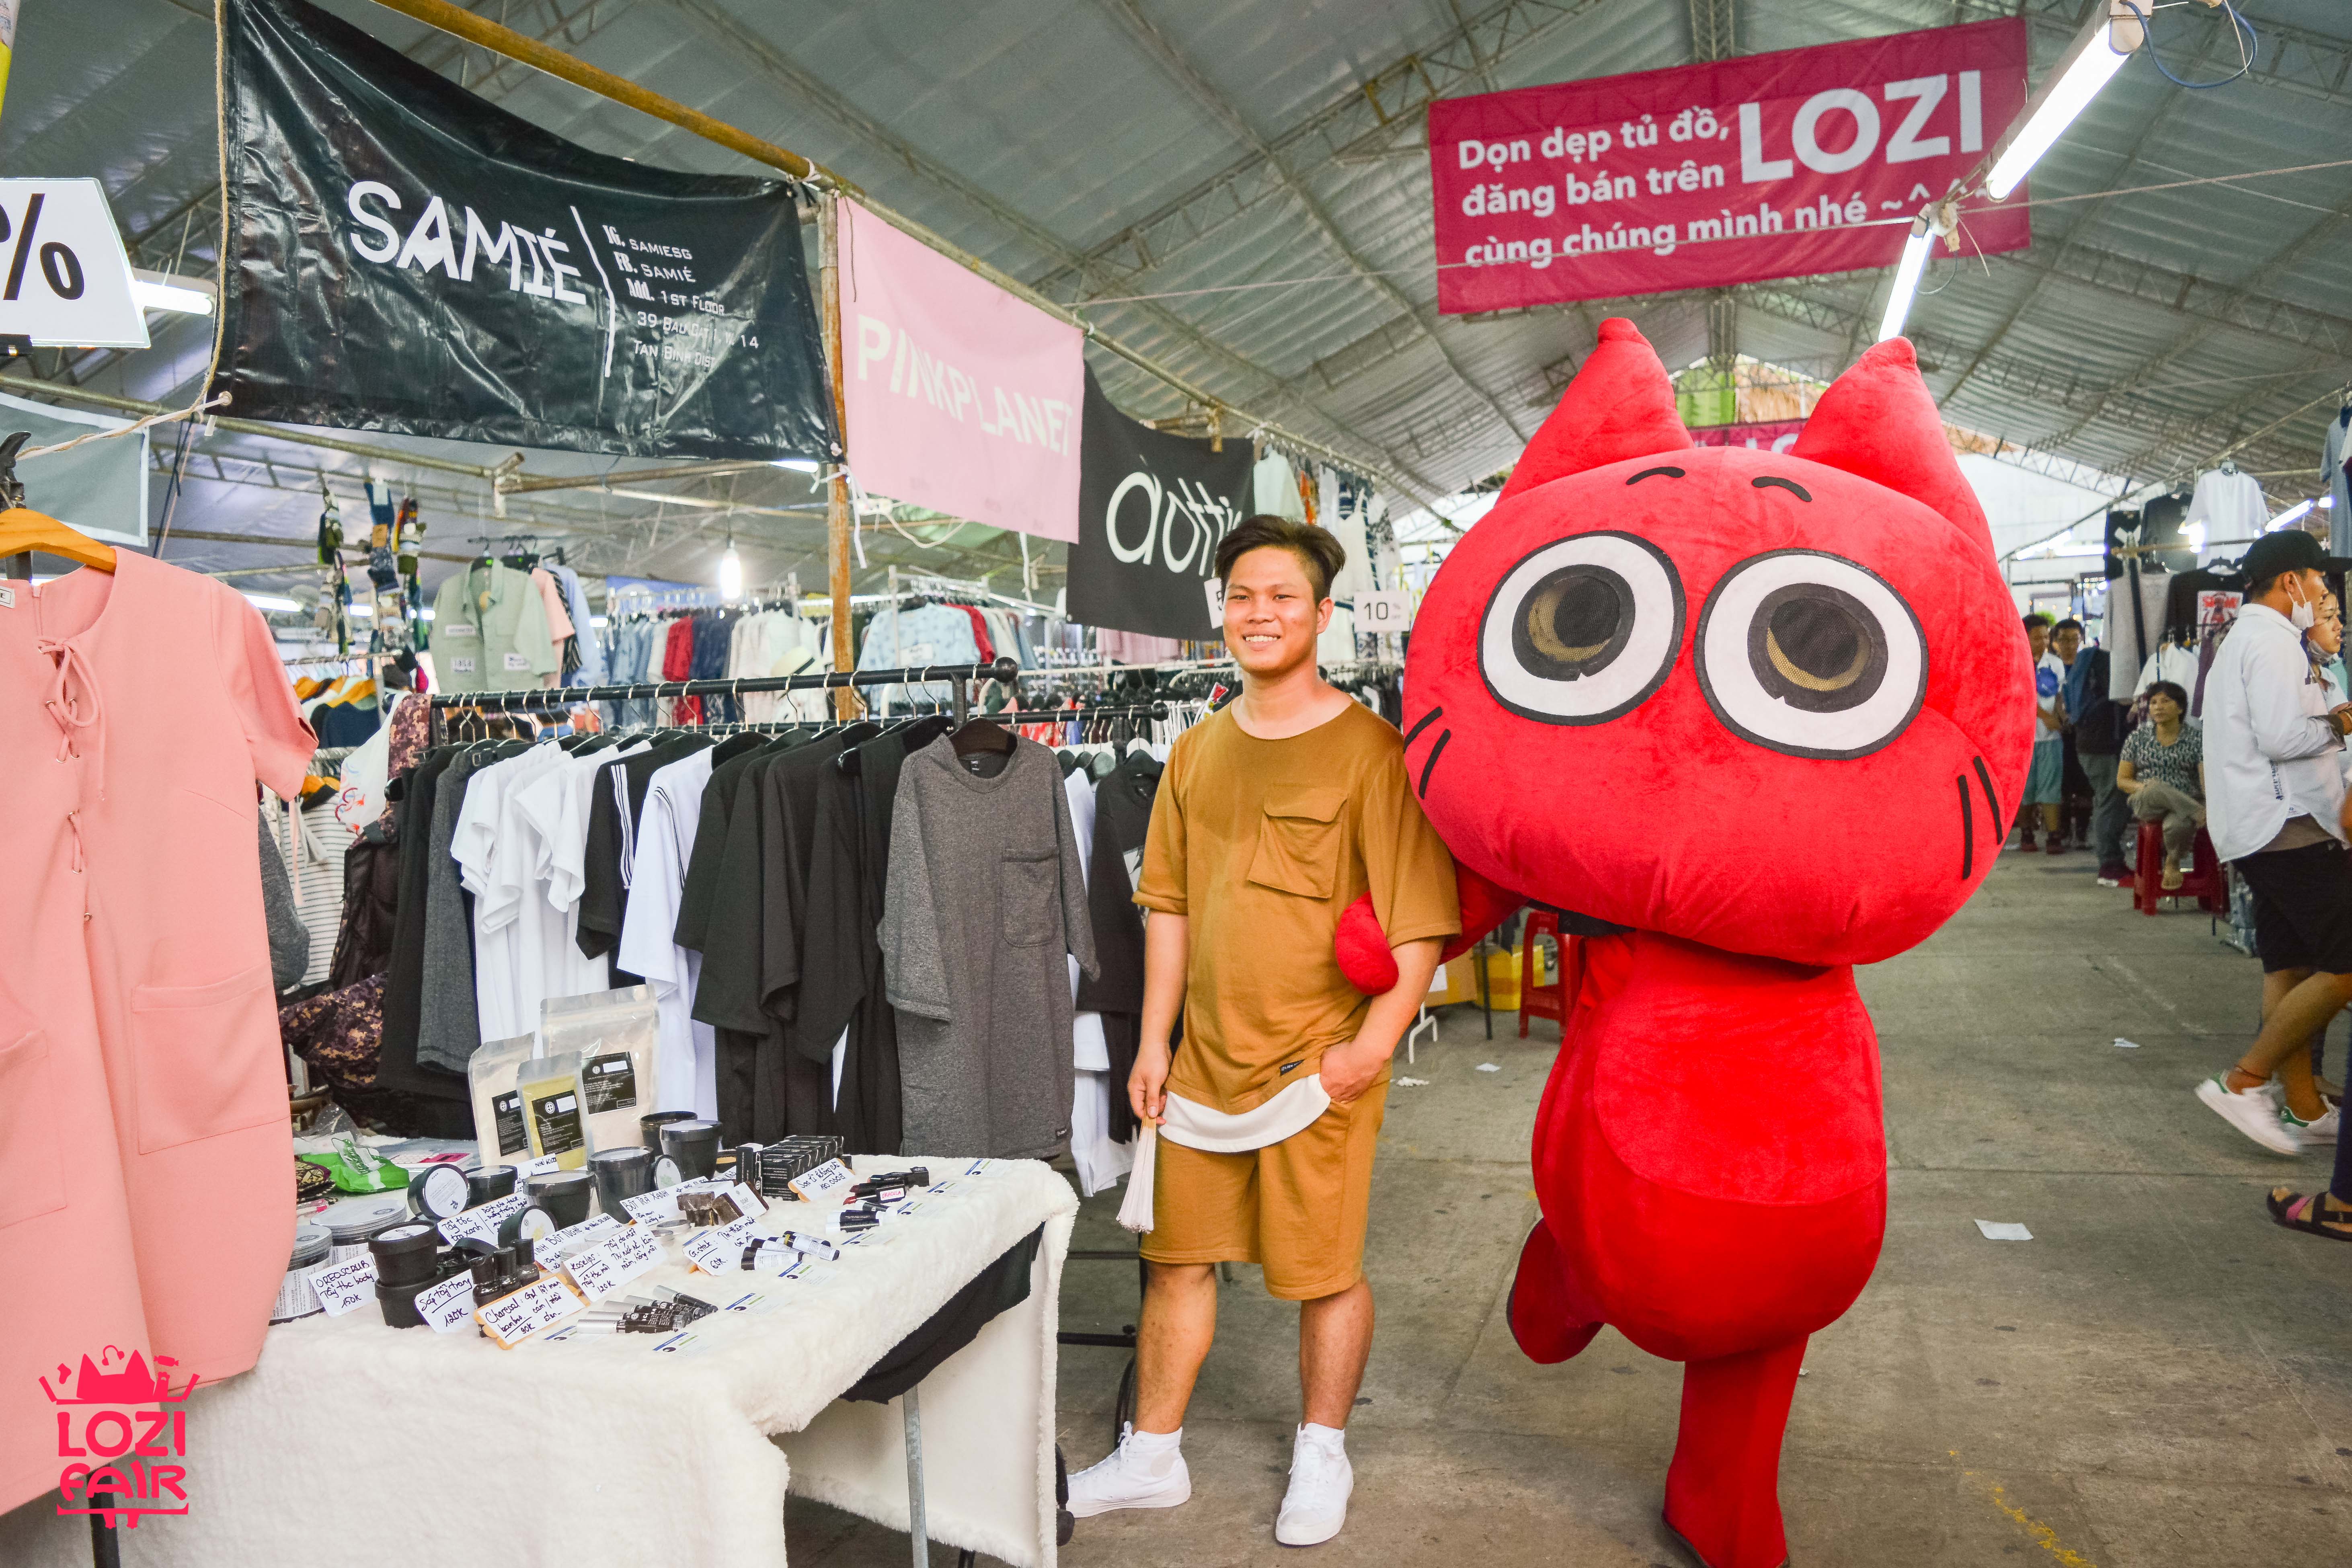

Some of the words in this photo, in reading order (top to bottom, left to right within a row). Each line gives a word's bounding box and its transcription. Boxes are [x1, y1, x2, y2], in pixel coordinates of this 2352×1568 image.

[1738, 70, 1983, 183] LOZI
[1458, 139, 1531, 173] Dọn
[1541, 126, 1611, 163] dẹp
[1620, 114, 1658, 149] tủ
[1669, 105, 1728, 142] đồ,
[1462, 183, 1555, 218] đăng
[1566, 170, 1636, 205] bán
[1646, 160, 1724, 195] trên
[1465, 236, 1552, 269] cùng
[1563, 222, 1675, 255] chúng
[1687, 207, 1783, 242] mình
[1795, 191, 1867, 228] nhé
[348, 181, 586, 306] SAMIÉ
[629, 239, 693, 260] SAMIESG
[640, 264, 696, 282] SAMIÉ
[637, 311, 657, 328] 39
[858, 314, 1073, 457] PINKPLANET
[1364, 602, 1388, 620] 10
[652, 1190, 670, 1201] XANH
[464, 1222, 484, 1238] xanh
[534, 1244, 549, 1255] INH
[316, 1260, 369, 1287] OREOSCRUB
[353, 1272, 375, 1284] body
